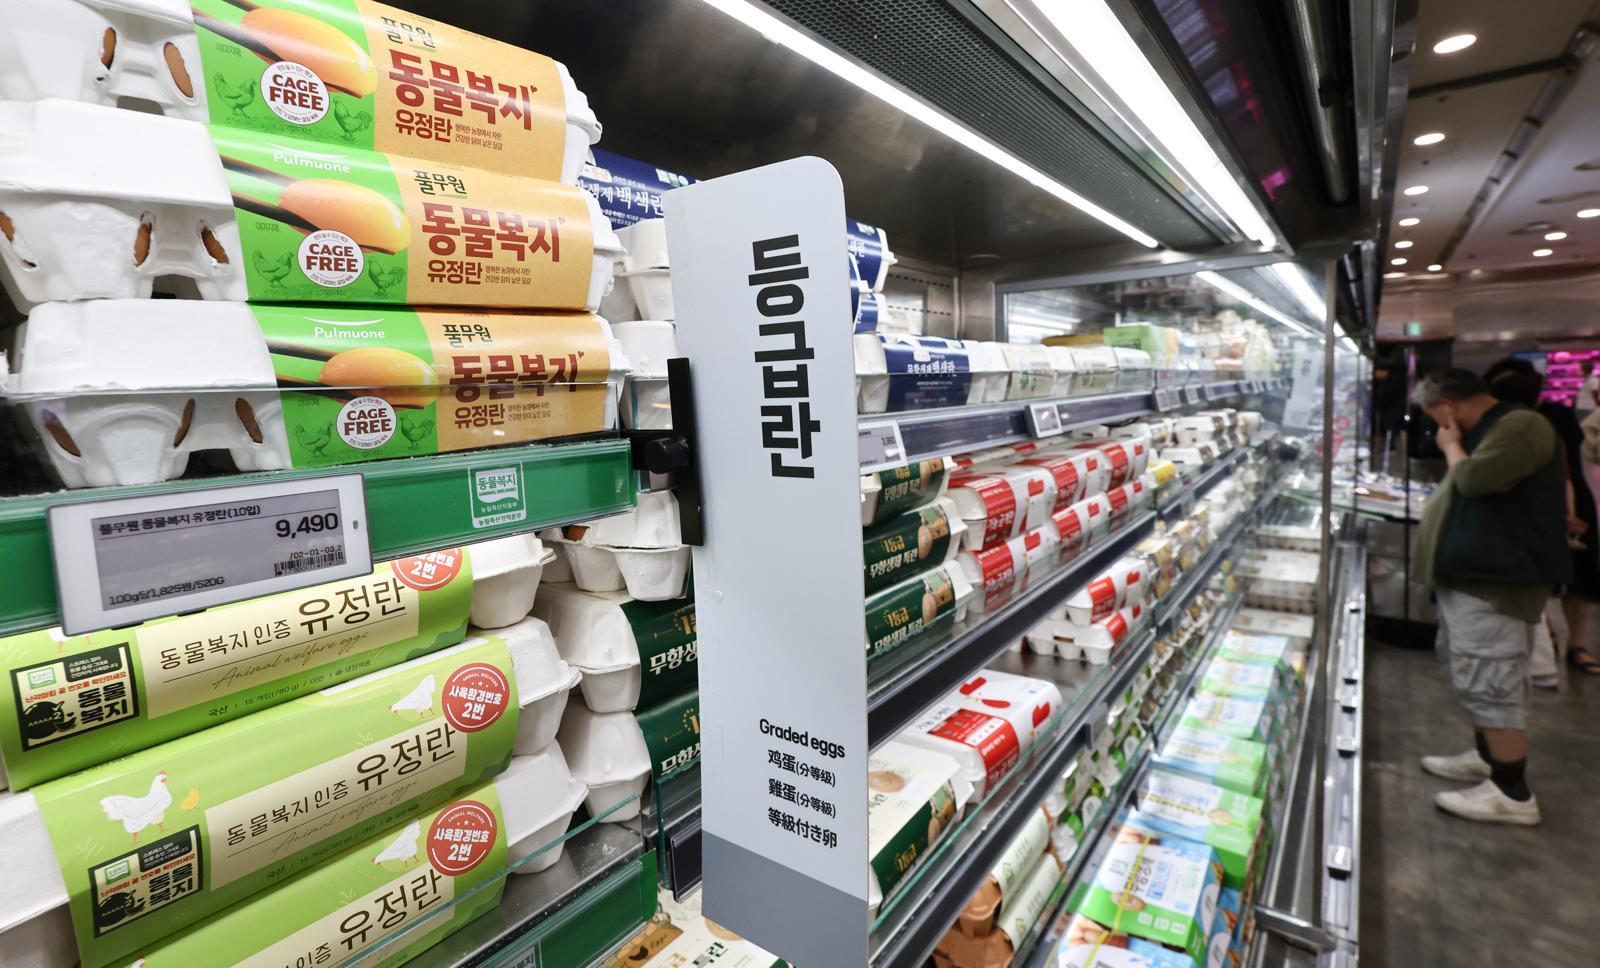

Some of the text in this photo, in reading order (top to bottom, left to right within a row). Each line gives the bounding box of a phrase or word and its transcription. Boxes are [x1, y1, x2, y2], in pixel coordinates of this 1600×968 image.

[381, 16, 436, 48] 풀무원
[272, 74, 318, 94] CAGE
[389, 49, 532, 131] 동물복지
[269, 86, 324, 111] FREE
[395, 109, 452, 143] 유정란
[273, 152, 351, 173] Pulmuone
[414, 170, 467, 196] 풀무원
[422, 202, 560, 262] 동물복지
[309, 243, 354, 257] CAGE
[306, 255, 358, 273] FREE
[428, 259, 483, 285] 유정란
[314, 327, 385, 339] Pulmuone
[443, 324, 493, 348] 풀무원
[748, 234, 821, 479] 등급란
[450, 353, 578, 403] 동물복지
[344, 419, 392, 436] FREE
[346, 408, 388, 421] CAGE
[455, 403, 505, 429] 유정란
[478, 473, 516, 490] 동물복지
[99, 520, 139, 535] 풀무원
[142, 514, 190, 531] 동물복지
[275, 512, 339, 539] 9,490
[411, 560, 437, 580] 2번
[160, 577, 406, 671] 동물복지 인증 유정란
[78, 681, 126, 709] 동물
[449, 685, 502, 705] 사육환경번호
[80, 699, 129, 725] 복지
[208, 705, 228, 718] 국산
[461, 702, 486, 720] 2번
[760, 719, 846, 759] Graded eggs
[768, 749, 836, 788] 鸡蛋(分等级)
[226, 722, 456, 846] 동물복지 인증 유정란
[768, 779, 836, 819] 雞蛋(分等級)
[434, 828, 489, 843] 사육환경번호
[768, 807, 838, 849] 等級付き卵
[448, 844, 472, 861] 2번
[149, 863, 193, 893] 동물
[150, 878, 193, 906] 복지
[296, 868, 442, 968] 인증 유정란
